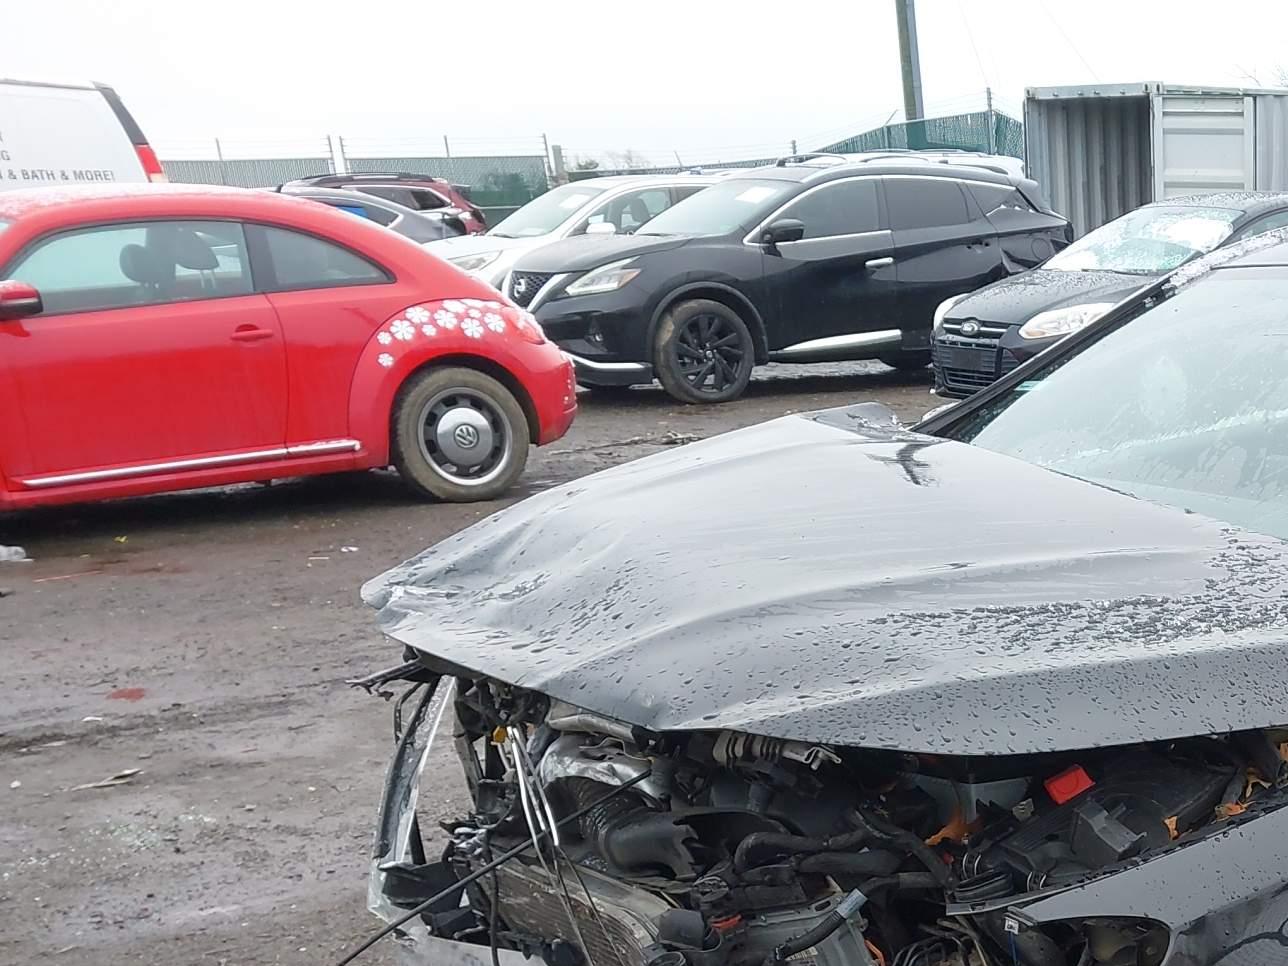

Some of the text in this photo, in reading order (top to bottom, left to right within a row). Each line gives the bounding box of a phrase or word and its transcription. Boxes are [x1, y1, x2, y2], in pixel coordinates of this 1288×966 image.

[8, 169, 17, 180] &
[20, 169, 56, 181] BATH
[60, 170, 69, 181] &
